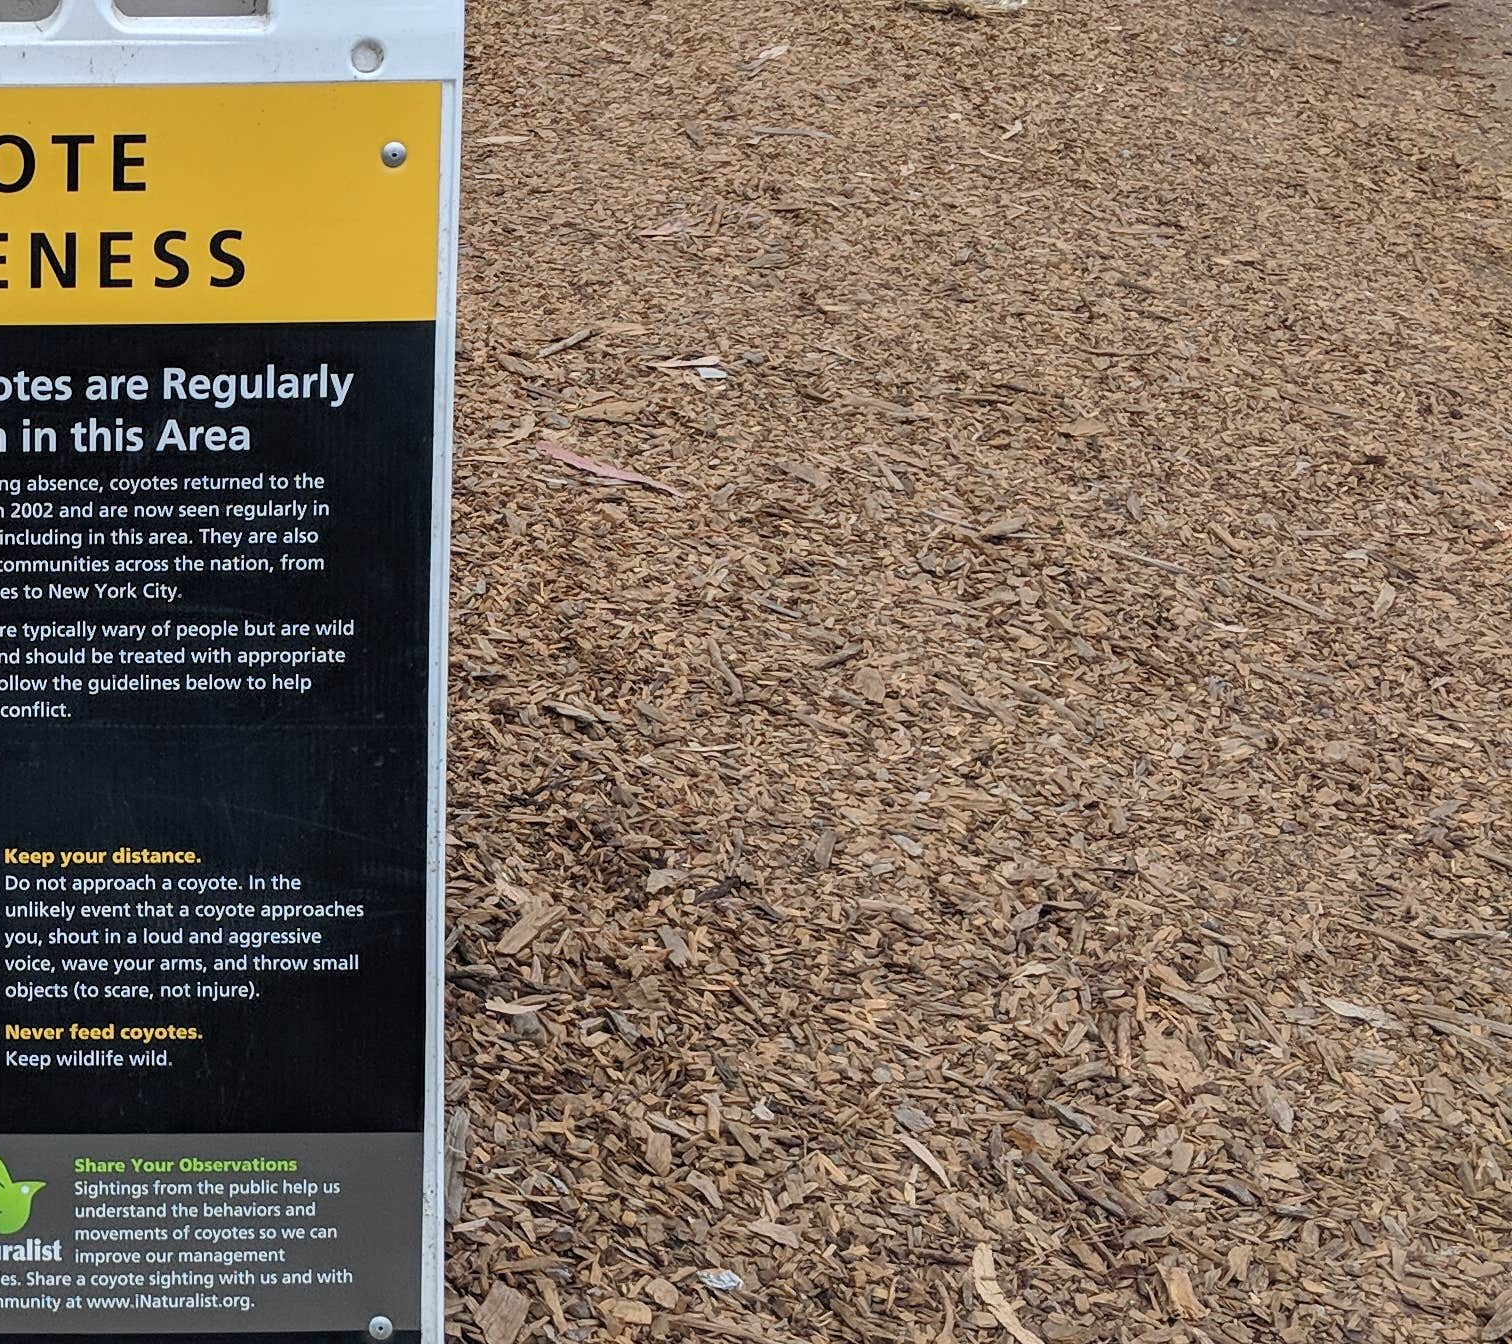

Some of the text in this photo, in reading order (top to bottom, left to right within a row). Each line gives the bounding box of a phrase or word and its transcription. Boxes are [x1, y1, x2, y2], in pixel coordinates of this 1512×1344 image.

[86, 375, 149, 400] are
[163, 363, 354, 409] Regularly
[23, 419, 56, 452] in
[70, 418, 143, 452] this
[156, 419, 250, 451] Area
[27, 474, 103, 493] absence,
[110, 476, 178, 494] coyotes
[184, 473, 263, 490] returned
[269, 475, 289, 489] to
[293, 472, 325, 489] the
[115, 559, 169, 572] across
[173, 555, 204, 571] the
[210, 555, 274, 573] nation,
[280, 554, 324, 570] from
[22, 620, 97, 641] typically
[102, 625, 146, 641] wary
[151, 620, 171, 637] of
[177, 620, 238, 640] people
[245, 620, 275, 636] but
[281, 624, 310, 636] are
[315, 619, 354, 636] wild
[5, 848, 55, 867] Keep
[60, 851, 107, 868] your
[112, 847, 201, 864] distance.
[5, 1024, 64, 1040] Never
[69, 1023, 114, 1040] feed
[120, 1025, 203, 1044] coyotes.
[6, 1050, 172, 1070] Keep wildlife wild.
[75, 1157, 297, 1172] Share Your Observations
[75, 1179, 340, 1199] Sightings from the public help us
[75, 1202, 315, 1218] understand the behaviors and
[75, 1225, 337, 1243] movements of coyotes so we can
[75, 1249, 285, 1267] improve our management
[26, 1271, 72, 1286] Share
[76, 1275, 86, 1286] a
[90, 1273, 144, 1289] coyote
[149, 1270, 214, 1289] sighting
[219, 1270, 255, 1285] with
[260, 1273, 277, 1284] us
[282, 1269, 312, 1284] and
[317, 1268, 353, 1283] with
[66, 1296, 82, 1309] at
[86, 1293, 255, 1311] www.iNaturalist.org.
